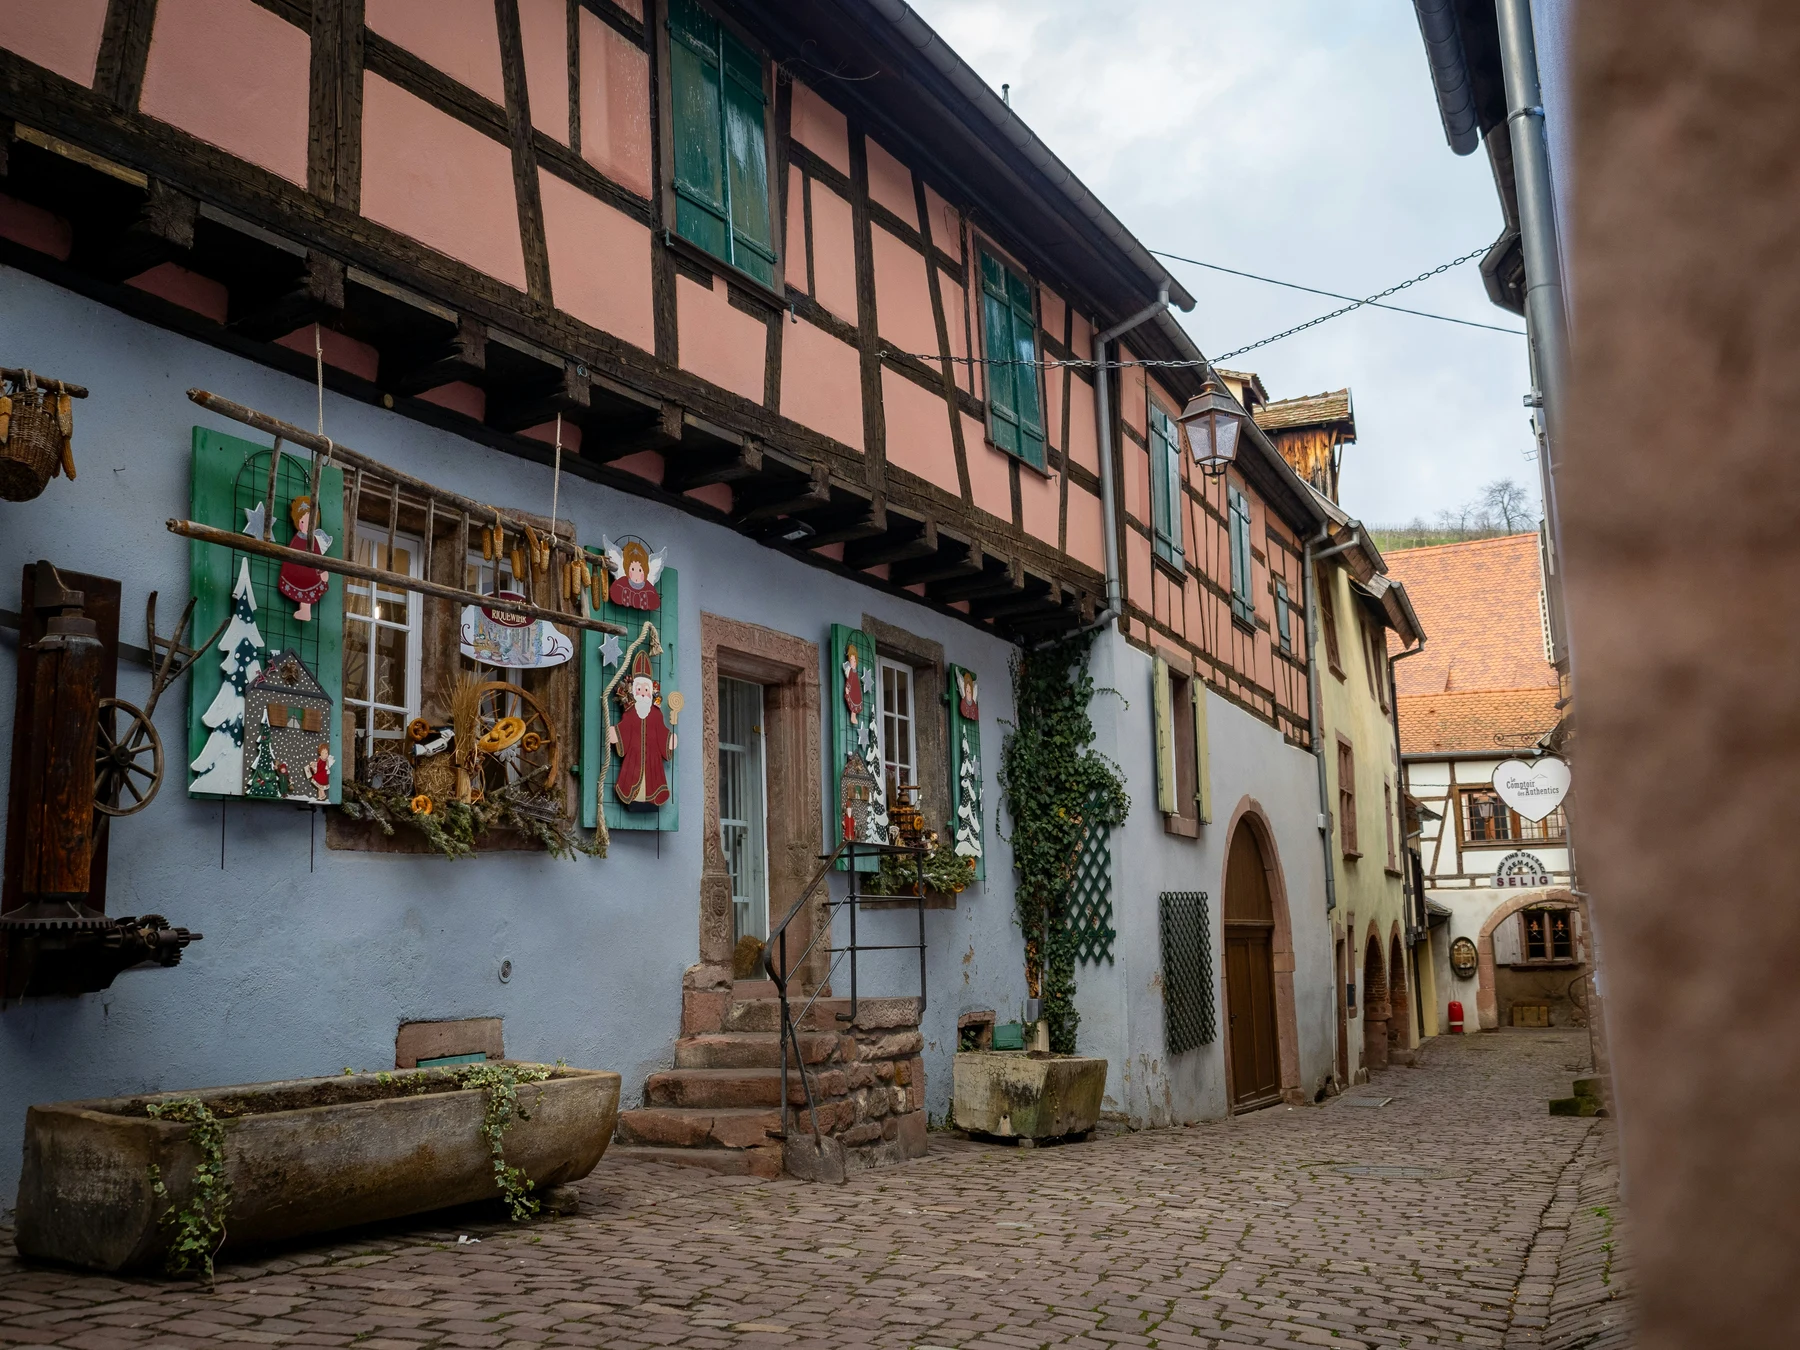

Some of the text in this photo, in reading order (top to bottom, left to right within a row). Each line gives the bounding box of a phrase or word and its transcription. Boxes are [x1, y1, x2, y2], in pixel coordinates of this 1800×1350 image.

[1506, 780, 1535, 790] Comptoir
[1525, 786, 1560, 796] Authentics
[1497, 852, 1546, 876] VINS FINS D'ALSACE
[1505, 860, 1537, 876] CREMANT
[1496, 875, 1549, 887] SELIG
